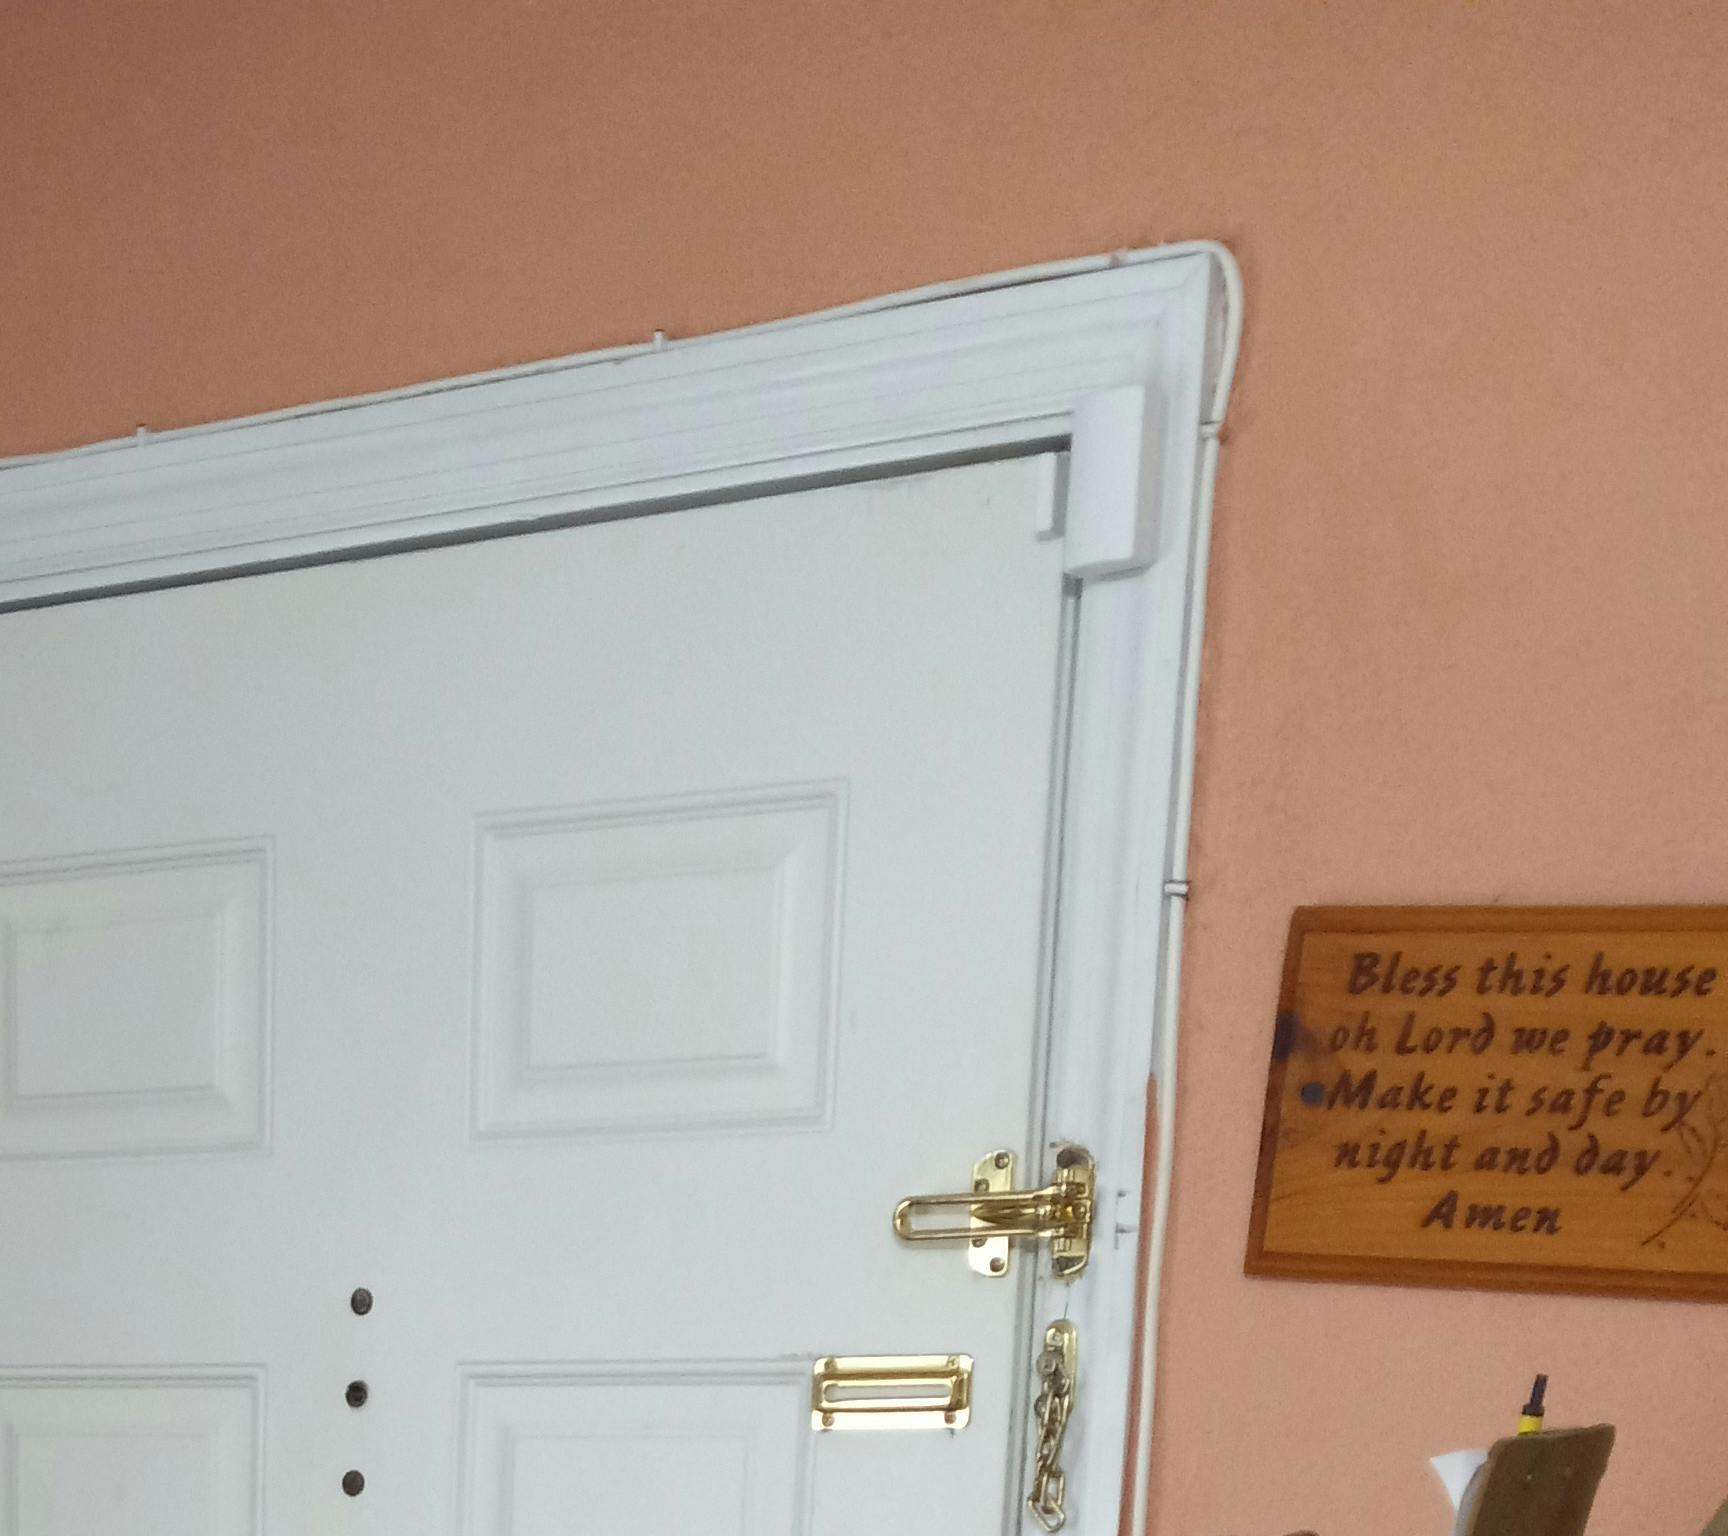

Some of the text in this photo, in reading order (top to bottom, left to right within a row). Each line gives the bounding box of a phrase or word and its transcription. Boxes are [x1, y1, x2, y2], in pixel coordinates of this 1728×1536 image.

[1348, 951, 1718, 998] Bless this house
[1330, 1012, 1376, 1055] oh
[1396, 1012, 1496, 1056] Lord
[1513, 1026, 1565, 1055] we
[1326, 1069, 1702, 1132] Make it safe by
[1335, 1129, 1460, 1184] night
[1474, 1133, 1560, 1176] and
[1422, 1189, 1563, 1233] Amen
